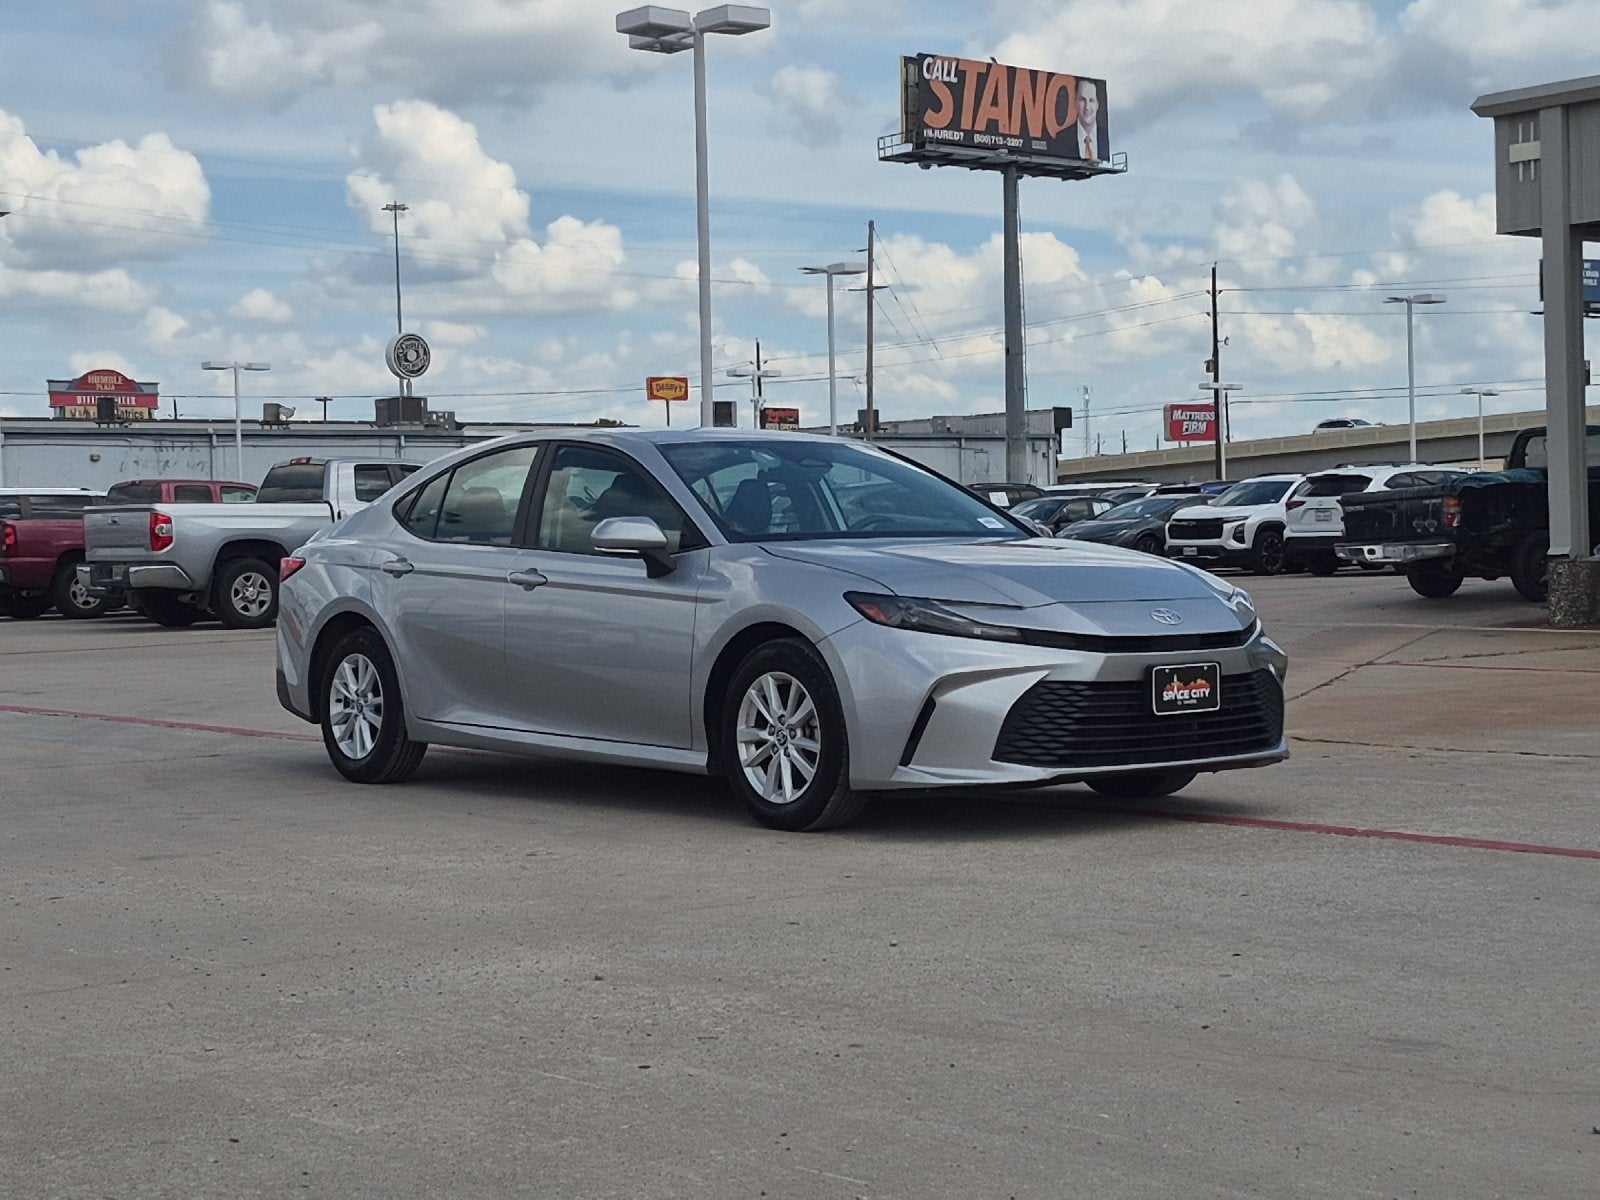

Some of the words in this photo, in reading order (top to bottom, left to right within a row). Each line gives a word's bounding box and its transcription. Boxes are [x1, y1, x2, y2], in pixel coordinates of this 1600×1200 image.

[922, 57, 958, 83] CALL
[923, 56, 1079, 139] STANO
[923, 129, 964, 141] INJURED?
[88, 375, 123, 384] HUMBLE
[1173, 410, 1215, 421] MATTRESS
[1183, 421, 1206, 434] FIRM
[1163, 690, 1189, 701] SPACE
[1191, 688, 1210, 698] CITY
